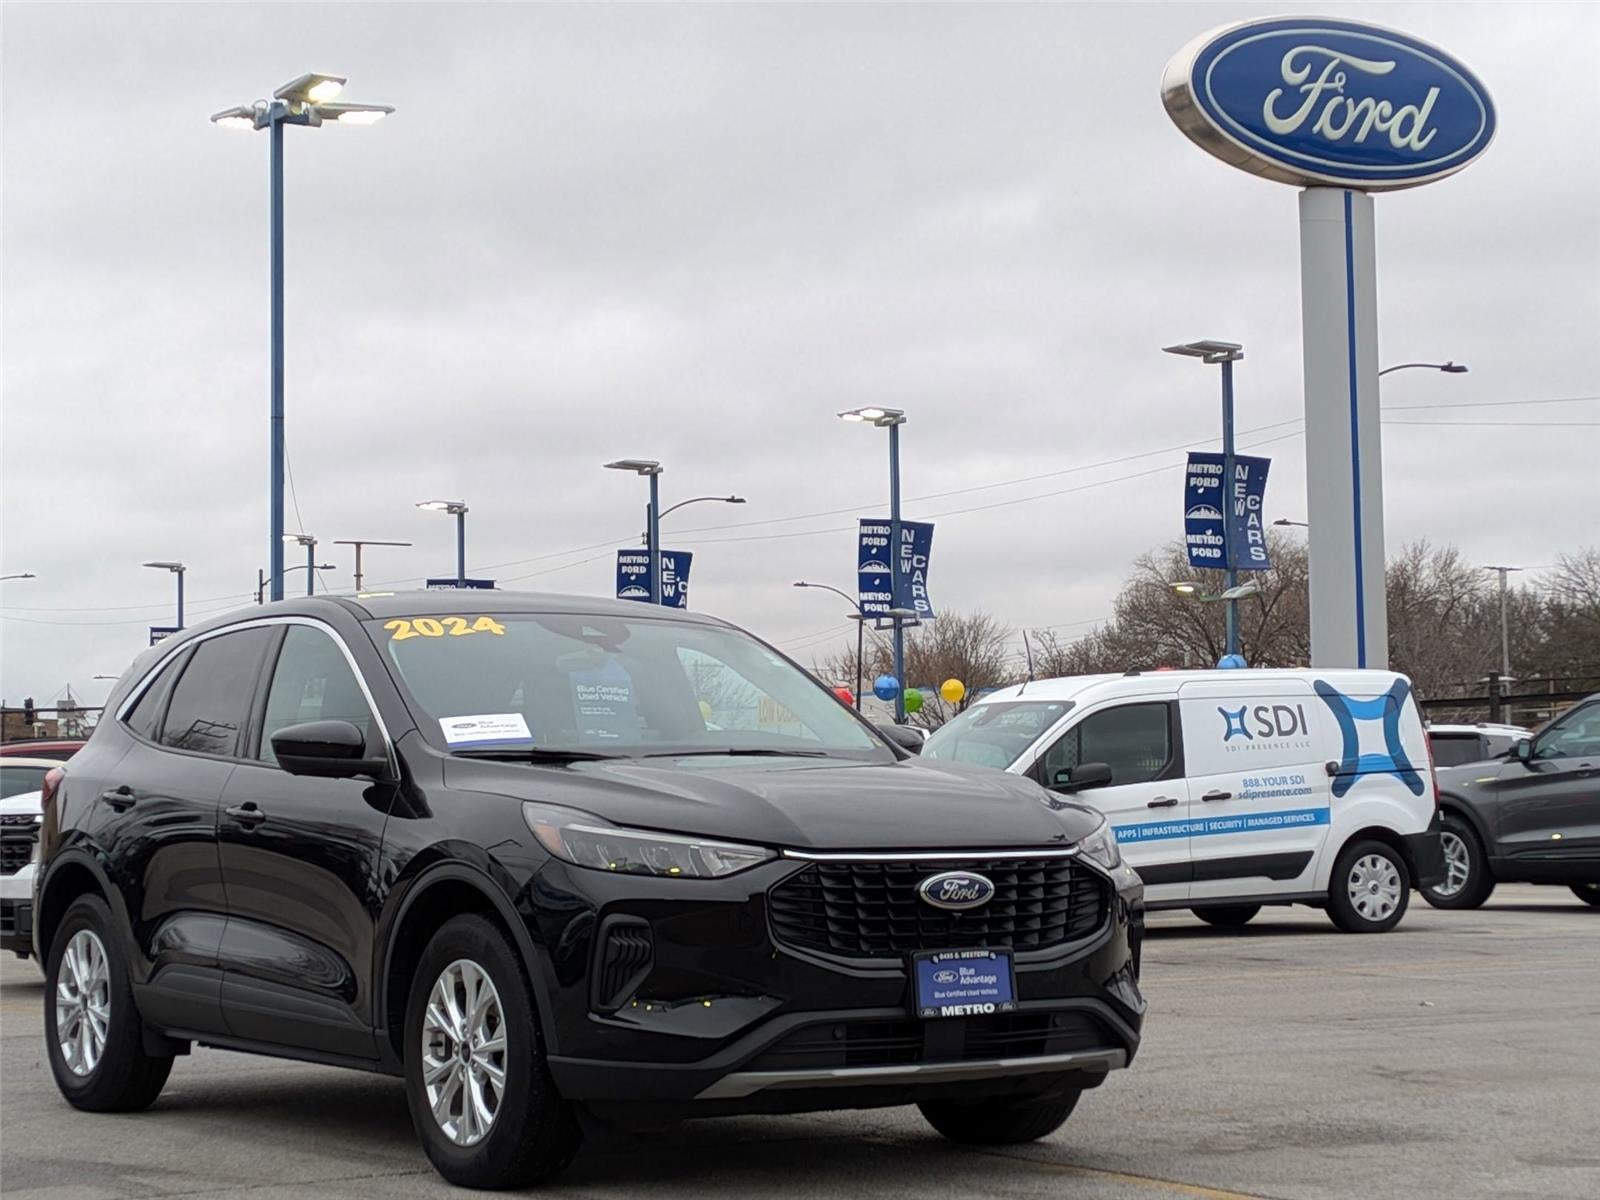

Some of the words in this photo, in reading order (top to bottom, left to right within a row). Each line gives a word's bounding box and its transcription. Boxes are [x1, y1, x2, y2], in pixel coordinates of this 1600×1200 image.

[1263, 45, 1440, 151] Ford
[1188, 463, 1223, 474] METRO
[1190, 477, 1219, 488] FORD
[1234, 465, 1249, 517] NEW
[860, 525, 891, 535] METRO
[1246, 495, 1267, 561] CARS
[862, 537, 888, 546] FORD
[1187, 534, 1223, 545] METRO
[900, 529, 915, 574] NEW
[1191, 547, 1221, 558] FORD
[619, 555, 649, 564] METRO
[621, 565, 647, 574] FORD
[662, 557, 675, 597] NEW
[912, 554, 929, 612] CARS
[860, 591, 892, 601] METRO
[864, 603, 890, 612] FORD
[383, 616, 505, 640] 2024
[1253, 704, 1308, 738] SDI
[1225, 745, 1241, 753] SDI
[1246, 742, 1290, 751] PRESENCE
[1242, 776, 1288, 788] 888.YOUR
[1289, 775, 1306, 785] SDI
[1237, 787, 1313, 800] sdipresence.com
[1117, 829, 1137, 838] APPS
[1142, 823, 1204, 837] INFRASTRUCTURE
[1209, 820, 1242, 831] SECURITY
[1248, 815, 1283, 827] MANAGED
[1284, 813, 1316, 824] SERVICES
[940, 879, 980, 901] Ford
[959, 967, 975, 976] Blue
[960, 975, 997, 985] Advantage
[941, 1002, 995, 1017] METRO
